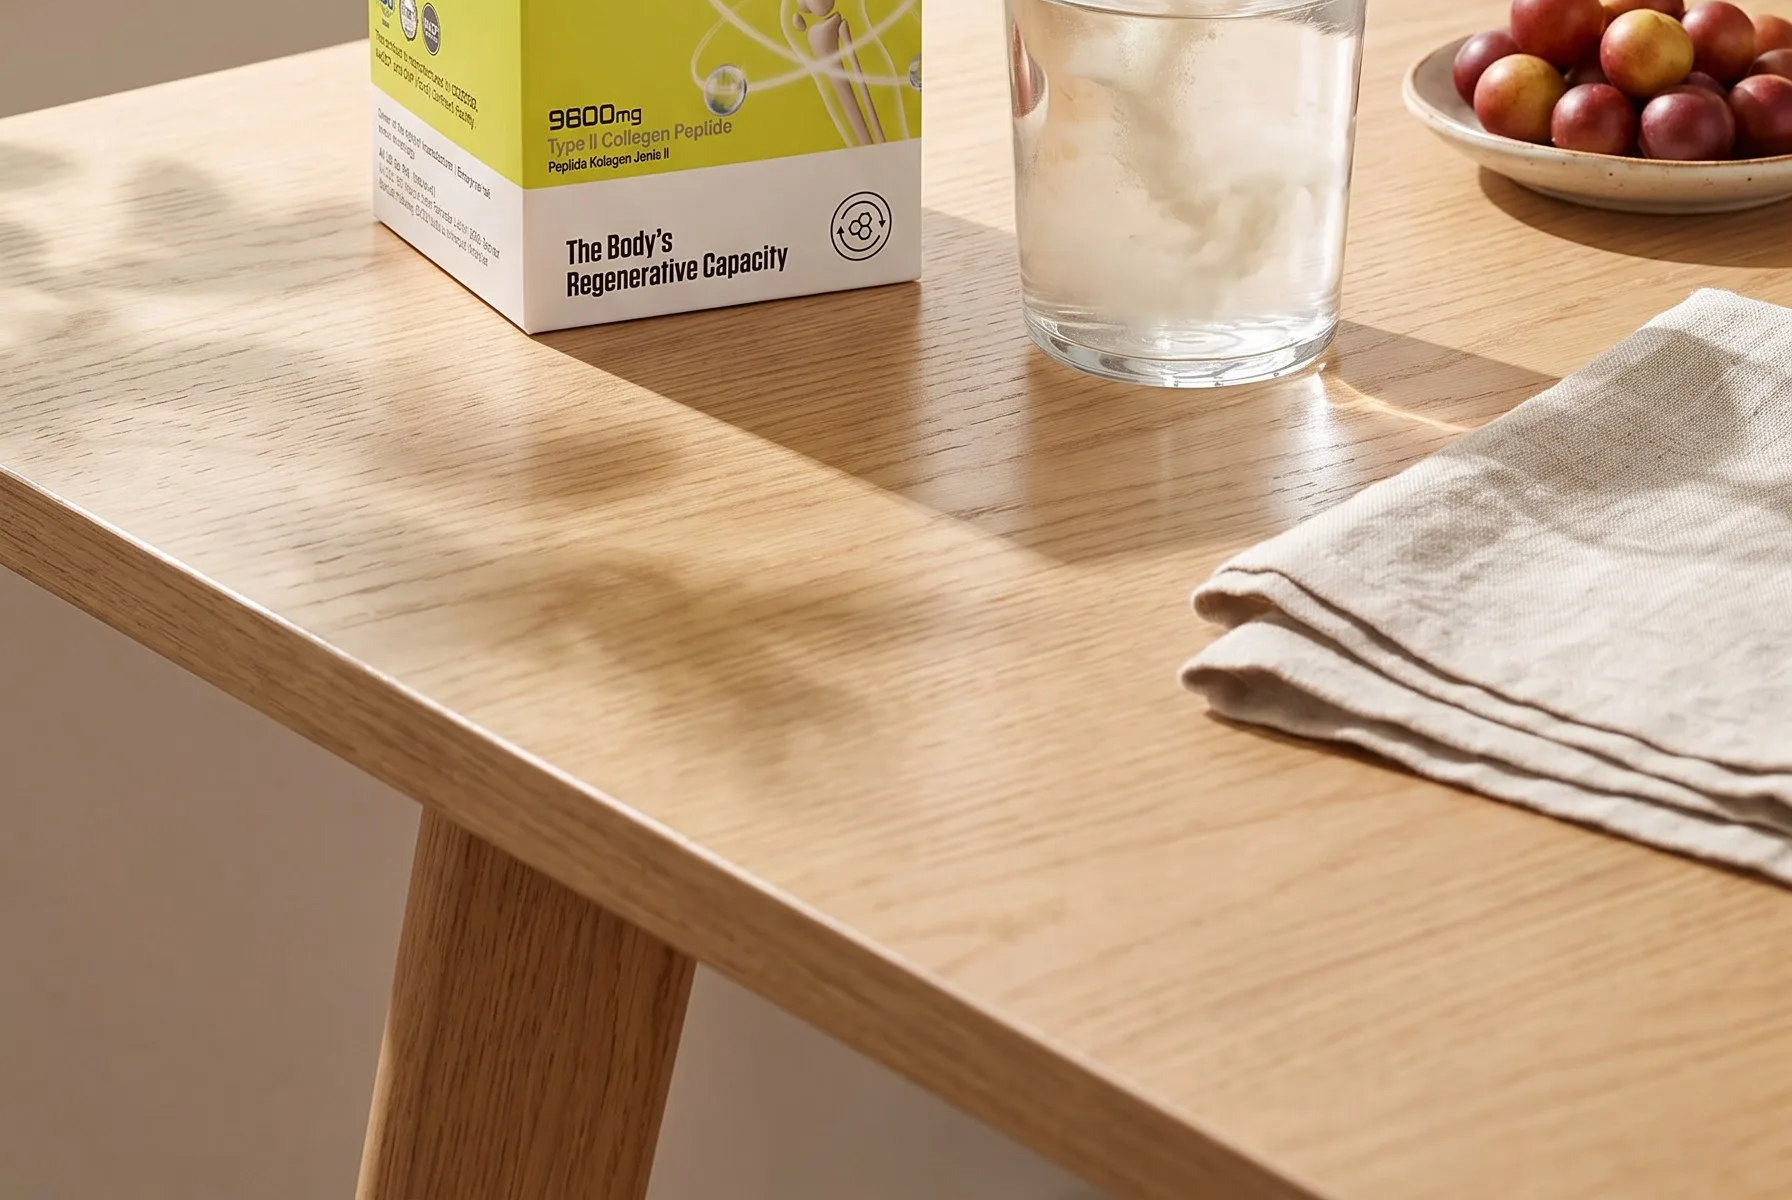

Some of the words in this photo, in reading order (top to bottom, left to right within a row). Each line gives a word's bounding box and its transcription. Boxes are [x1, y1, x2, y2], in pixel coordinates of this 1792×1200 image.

[547, 137, 586, 158] Type
[589, 133, 598, 150] II
[589, 154, 632, 169] Kolagen
[633, 148, 662, 163] Jenis
[565, 238, 602, 265] The
[607, 228, 673, 260] Body’s
[567, 258, 698, 298] Regenerative
[702, 244, 789, 279] Capacity
